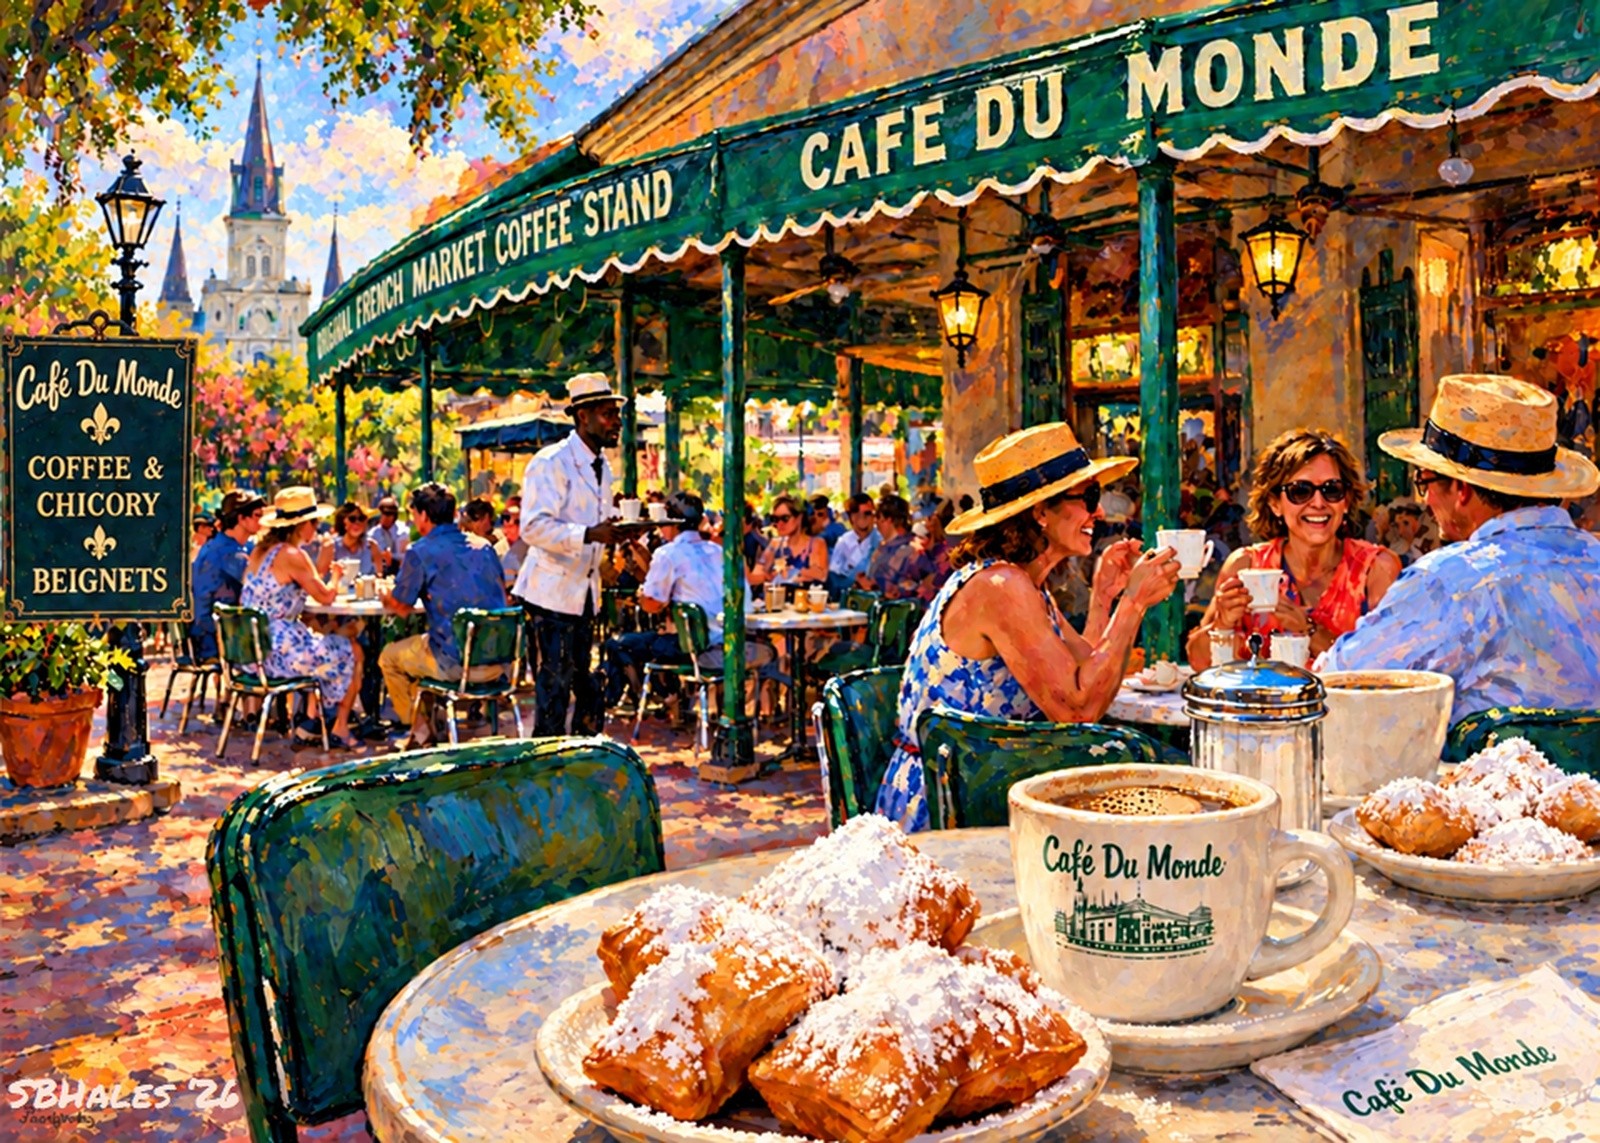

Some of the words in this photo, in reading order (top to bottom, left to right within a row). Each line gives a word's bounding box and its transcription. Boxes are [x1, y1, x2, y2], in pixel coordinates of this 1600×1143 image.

[799, 102, 946, 191] CAFE
[975, 72, 1065, 151] DU
[1126, 1, 1440, 120] MONDE
[356, 268, 403, 329] FRENCH
[412, 230, 487, 298] MARKET
[494, 200, 572, 266] COFFEE
[583, 169, 673, 238] STAND
[16, 360, 72, 412] Café
[76, 359, 110, 397] Du
[114, 358, 182, 409] Monde
[27, 456, 131, 480] COFFEE
[144, 456, 164, 480] &
[36, 491, 160, 517] CHICORY
[33, 567, 168, 594] BEIGNETS
[1043, 835, 1095, 881] Café
[1101, 843, 1139, 879] Du
[1147, 843, 1224, 880] Monde
[1342, 1078, 1413, 1116] Café
[1405, 1069, 1464, 1095] Du
[1456, 1039, 1557, 1081] Monde
